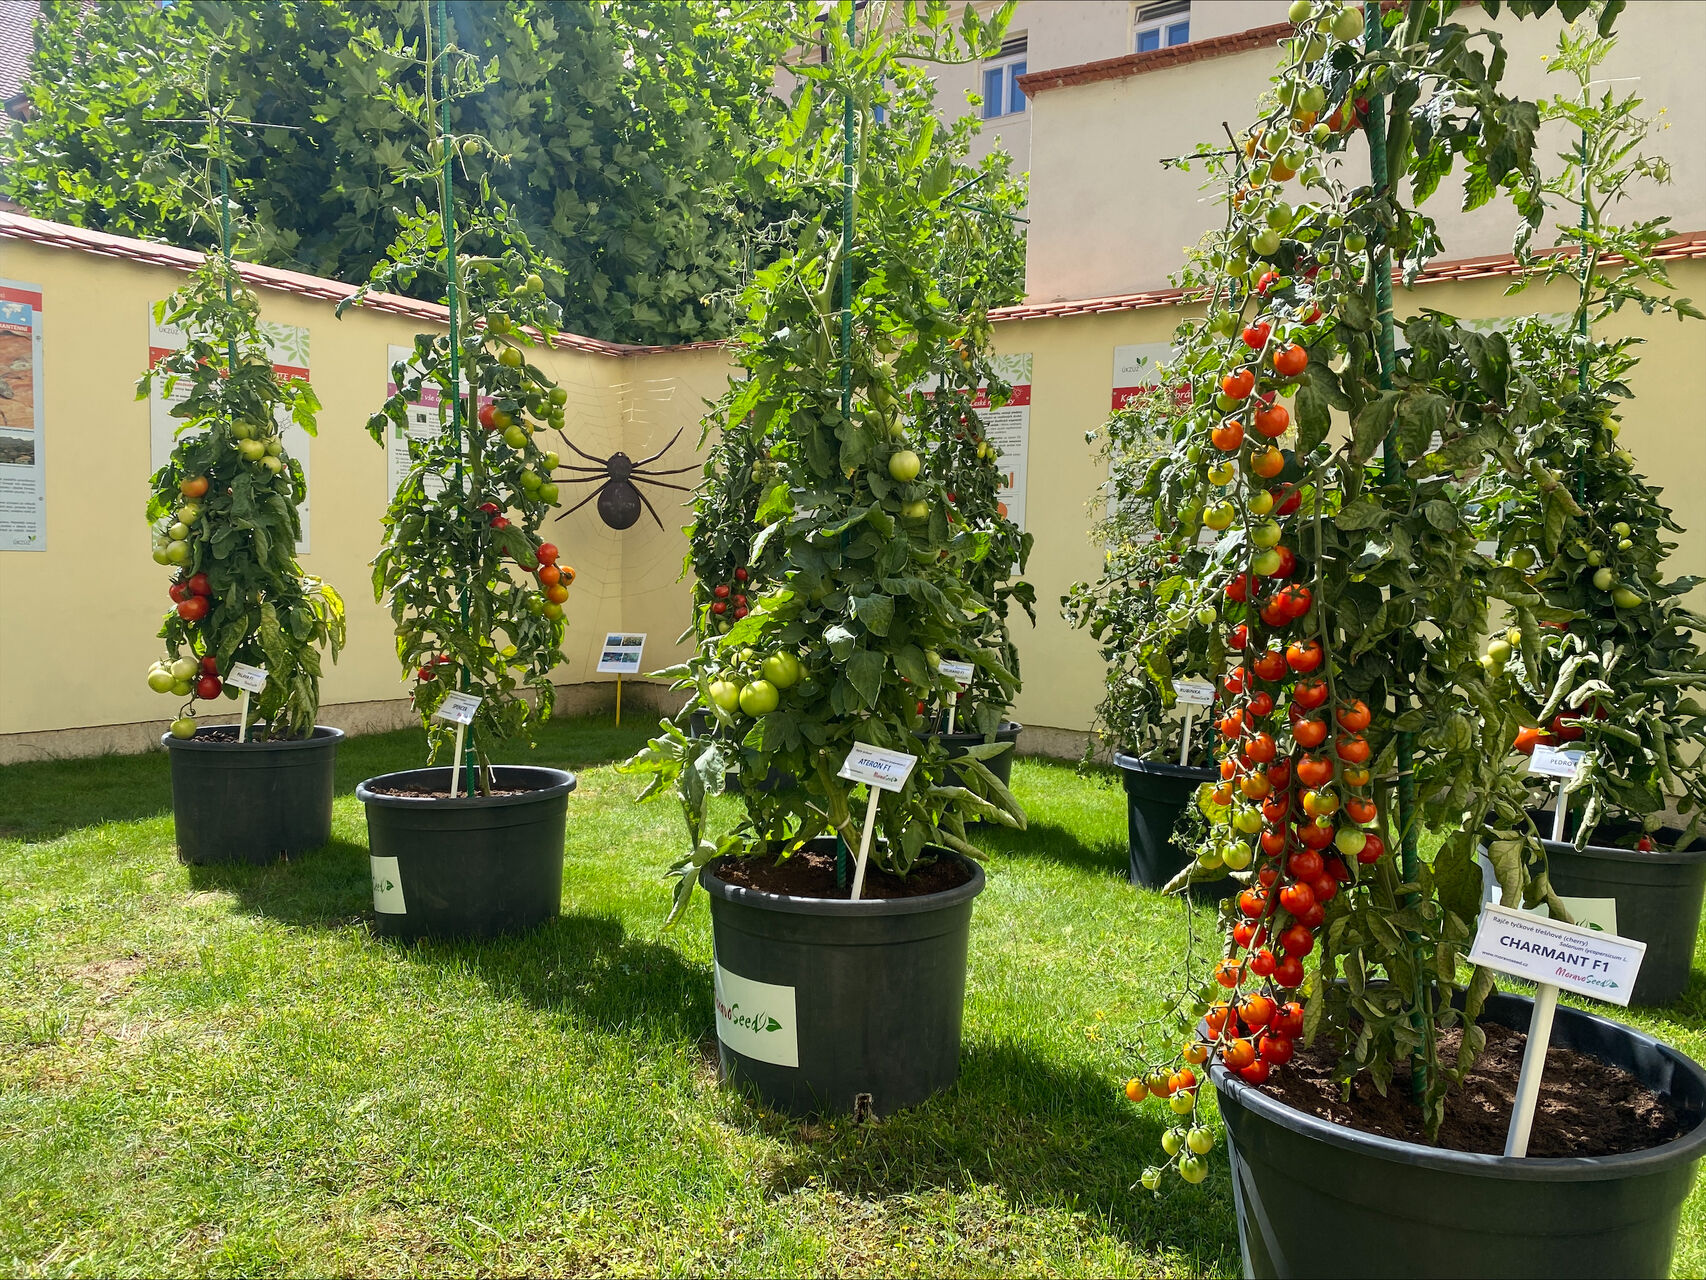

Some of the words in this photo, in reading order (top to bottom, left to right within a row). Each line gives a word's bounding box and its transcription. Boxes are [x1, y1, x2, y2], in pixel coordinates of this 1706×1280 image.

[858, 758, 883, 770] ATERON
[1550, 759, 1573, 767] PEDRO
[1493, 916, 1510, 926] Rajče
[1510, 921, 1534, 933] tyčkové
[1563, 935, 1589, 947] (cherry)
[1500, 935, 1590, 967] CHARMANT
[1592, 959, 1610, 973] F1
